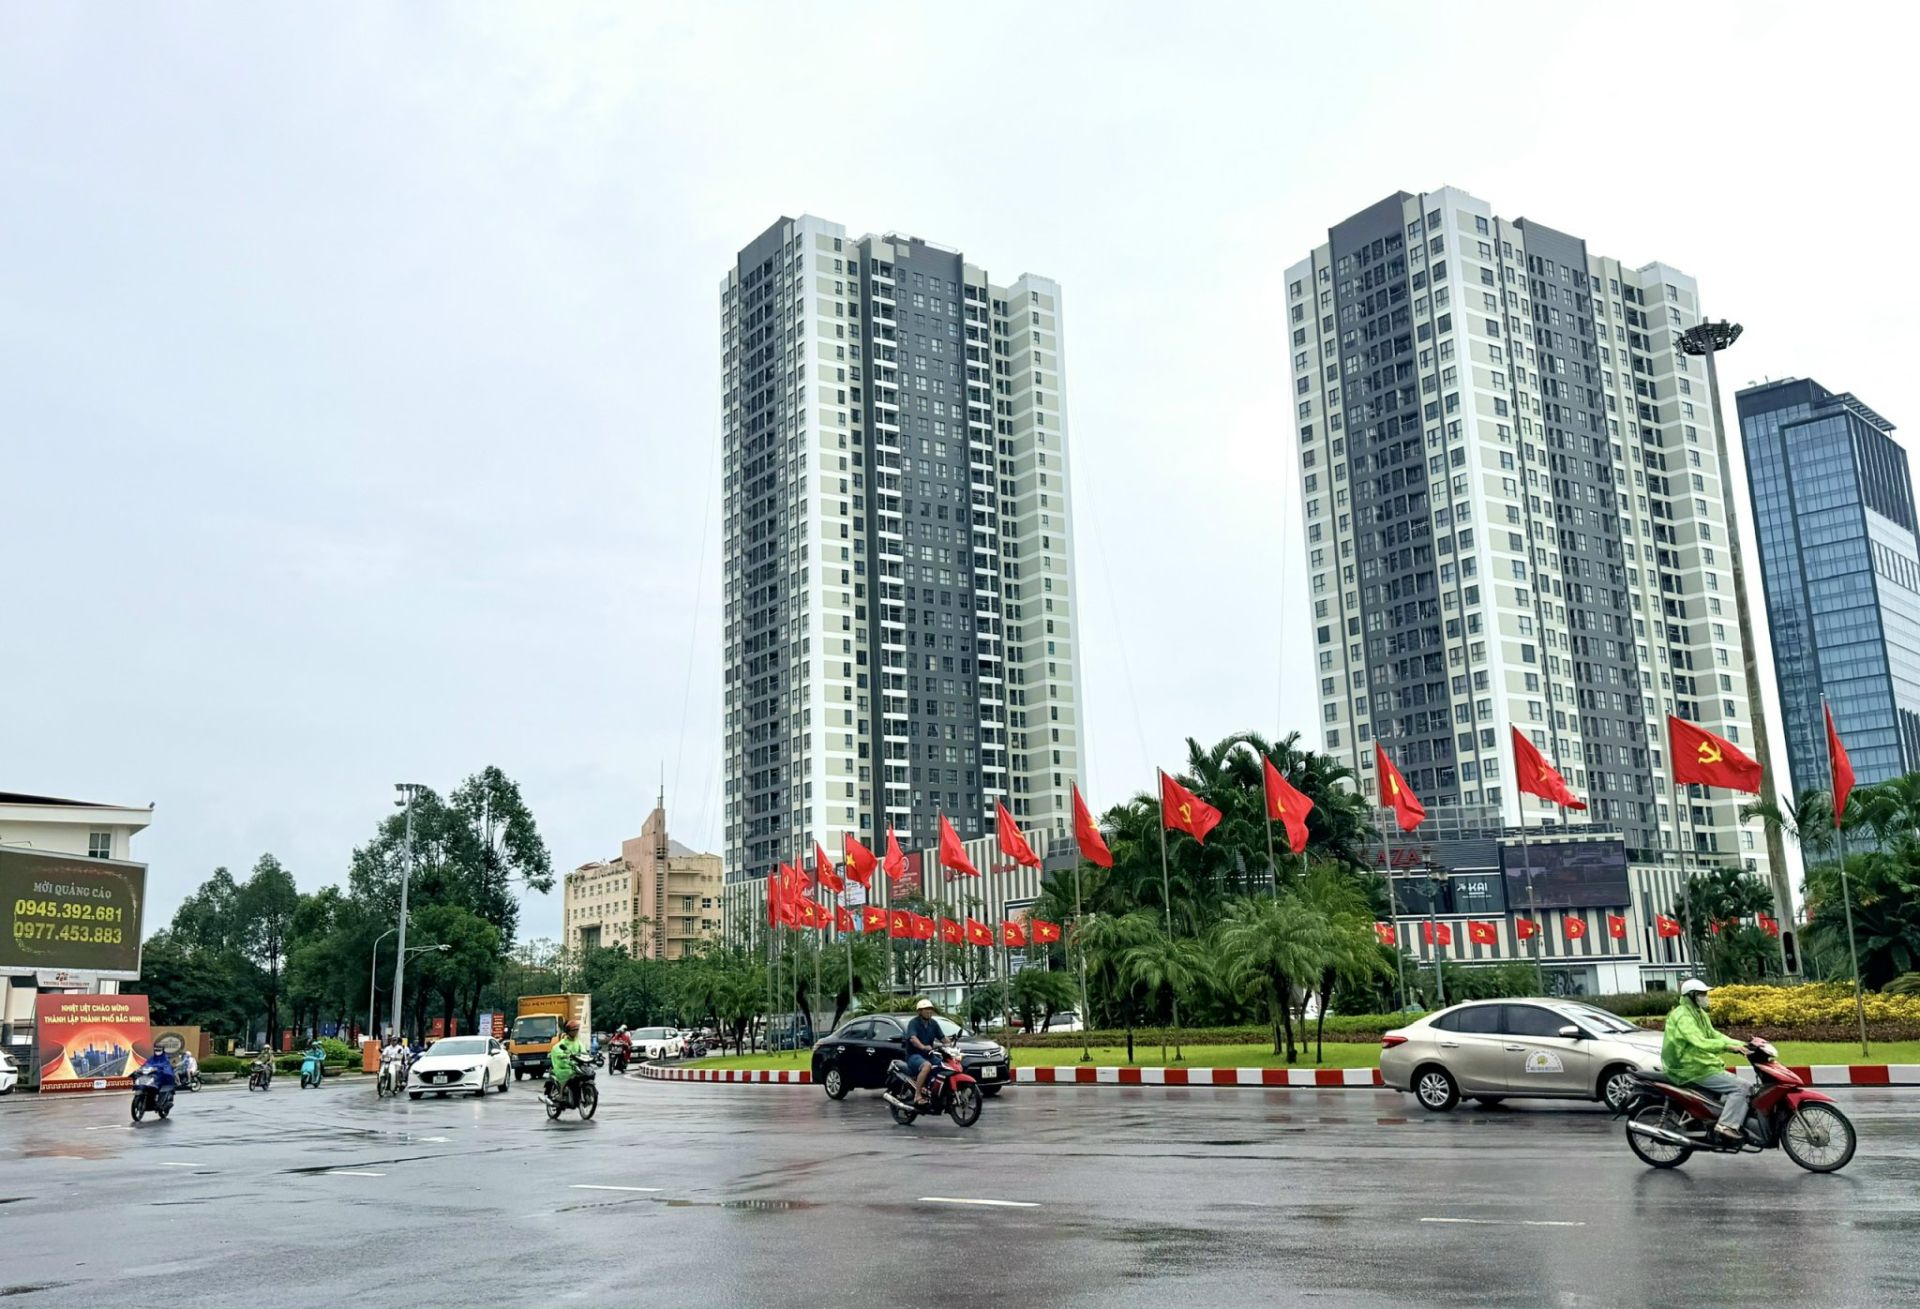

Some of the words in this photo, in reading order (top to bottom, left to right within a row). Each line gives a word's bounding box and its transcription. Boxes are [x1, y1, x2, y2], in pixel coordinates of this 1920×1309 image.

[54, 882, 90, 897] QUẢNG
[91, 886, 112, 899] CÁO
[1468, 882, 1488, 892] KAI
[15, 899, 122, 922] 0945.392.681
[13, 921, 122, 944] 0977.453.883
